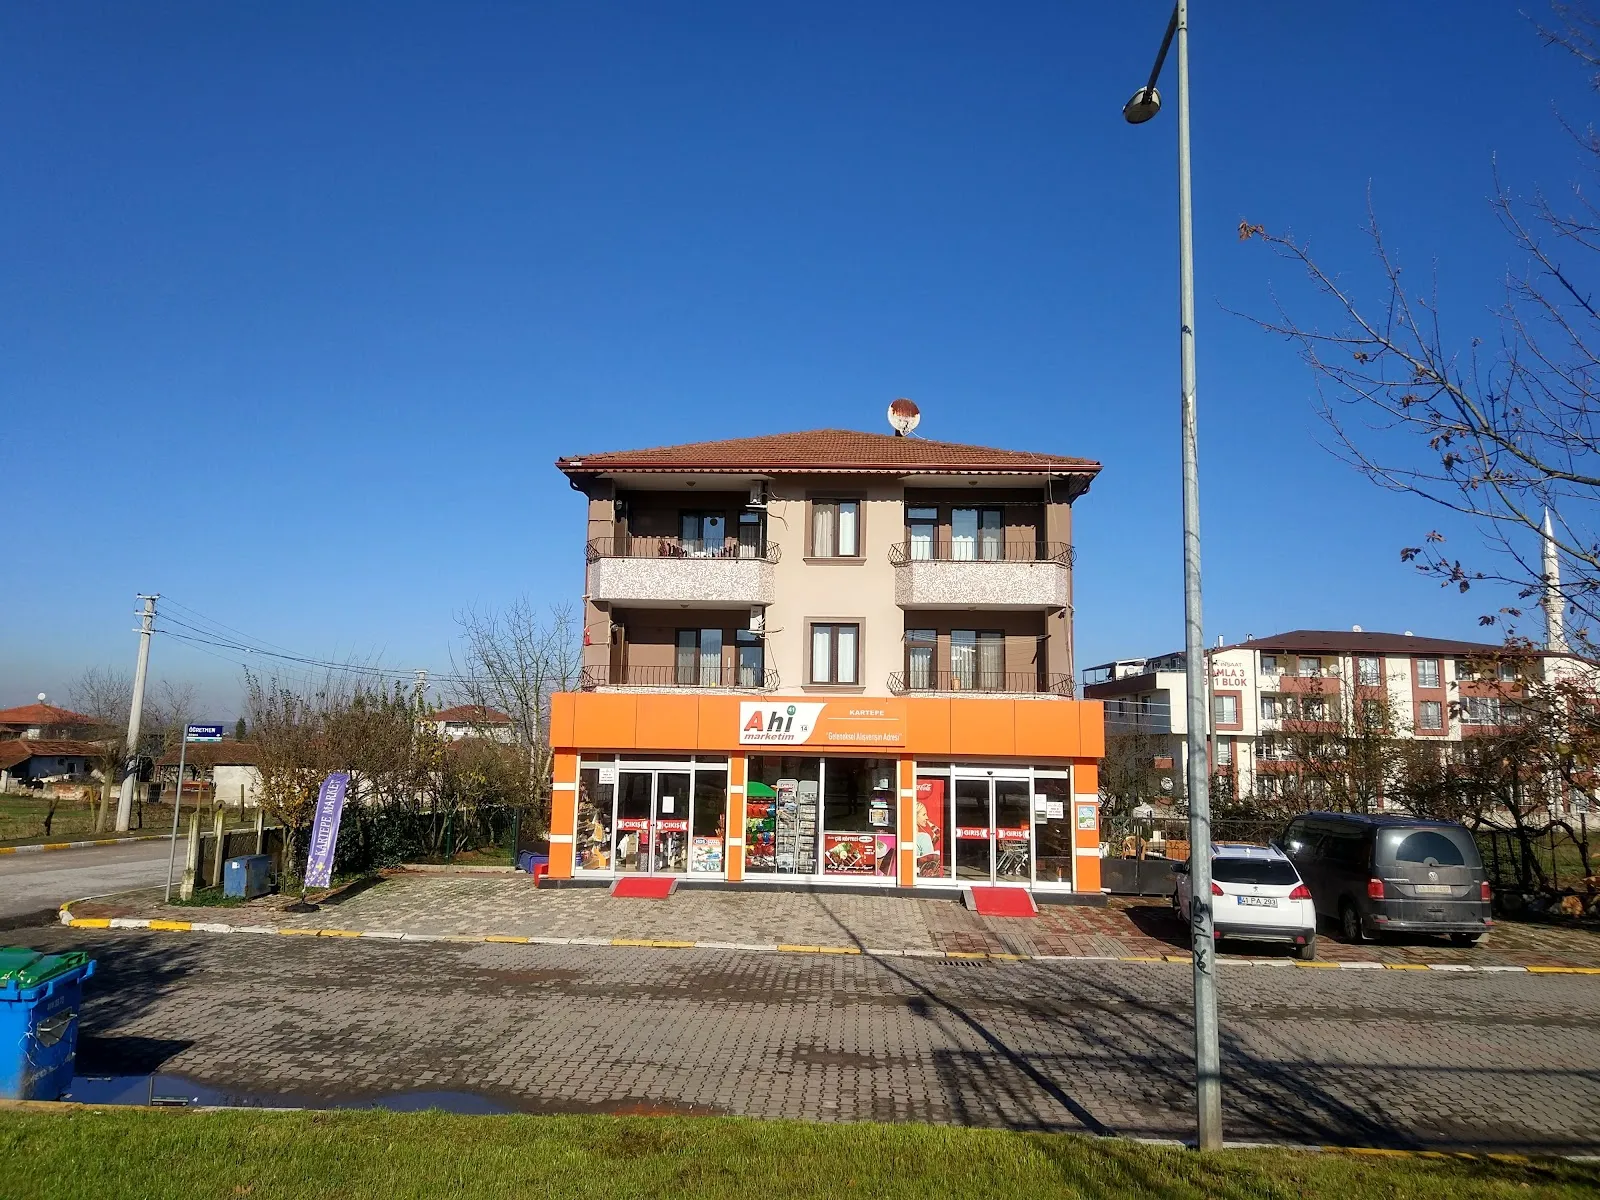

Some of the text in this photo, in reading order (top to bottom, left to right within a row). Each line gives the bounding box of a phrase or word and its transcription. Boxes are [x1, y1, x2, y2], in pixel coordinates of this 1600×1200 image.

[1239, 669, 1245, 677] 3
[1222, 678, 1247, 686] BLOK
[744, 706, 794, 732] Ahi
[744, 733, 794, 741] marketim
[314, 779, 341, 857] KARTEPE MARKET
